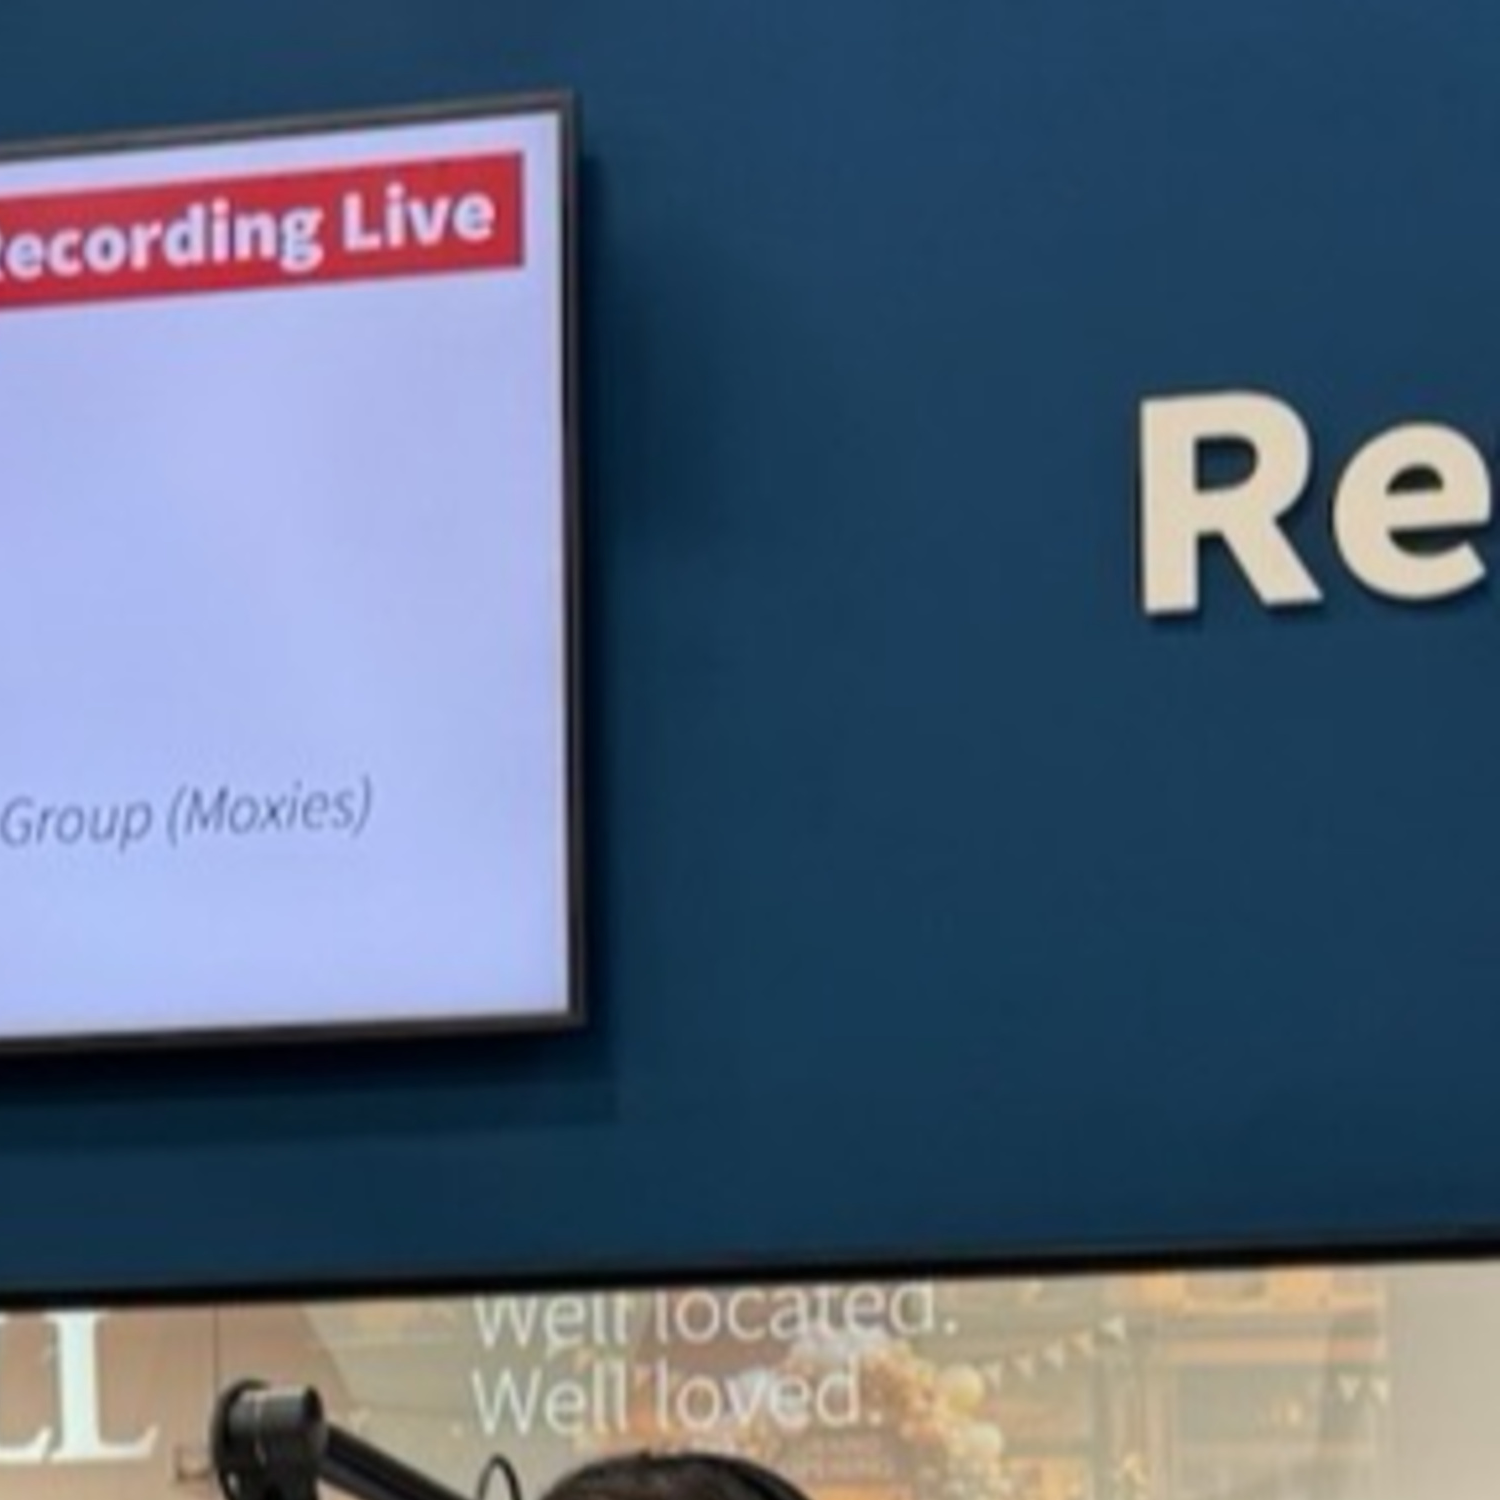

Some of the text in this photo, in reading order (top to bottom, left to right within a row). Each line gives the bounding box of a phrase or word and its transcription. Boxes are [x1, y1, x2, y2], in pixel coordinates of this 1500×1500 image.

[343, 183, 496, 252] Live
[1140, 389, 1492, 614] Re
[0, 796, 152, 852] Group
[167, 777, 374, 847] (Moxies)
[474, 1282, 959, 1350] Well located.
[474, 1357, 884, 1434] Well loved.
